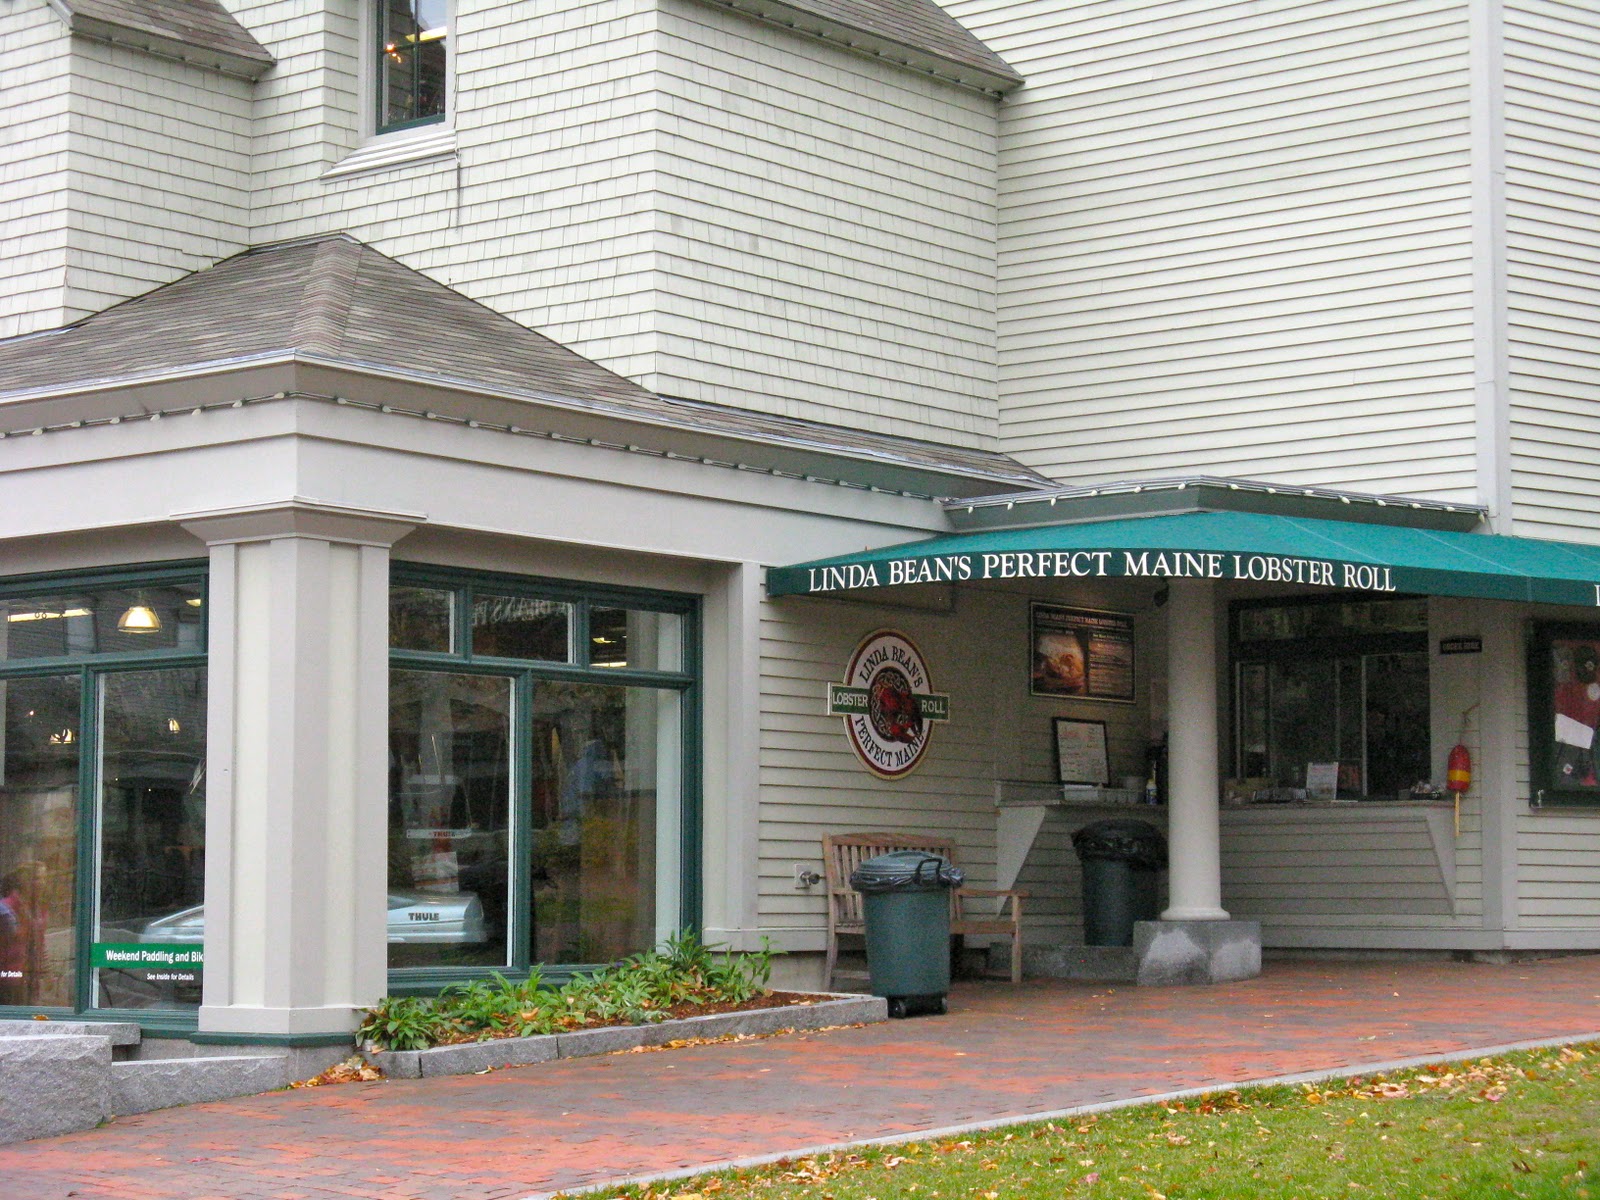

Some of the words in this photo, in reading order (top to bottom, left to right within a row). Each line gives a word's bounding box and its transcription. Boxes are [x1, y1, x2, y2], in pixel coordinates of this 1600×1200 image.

[809, 563, 880, 592] LINDA
[889, 556, 971, 585] BEAN'S
[982, 551, 1112, 579] PERFECT
[1124, 551, 1224, 578] MAINE
[1233, 554, 1336, 587] LOBSTER
[1343, 563, 1397, 592] ROLL
[859, 646, 889, 683] LINDA
[892, 645, 924, 688] BEAN'S
[832, 693, 869, 707] LOBSTER
[921, 699, 946, 714] ROLL
[855, 716, 893, 768] PERFECT
[896, 734, 925, 768] MAINE
[408, 912, 440, 921] THULE
[106, 950, 140, 961] Weekend
[141, 951, 174, 964] Paddling
[175, 952, 190, 962] and
[178, 973, 195, 981] Details
